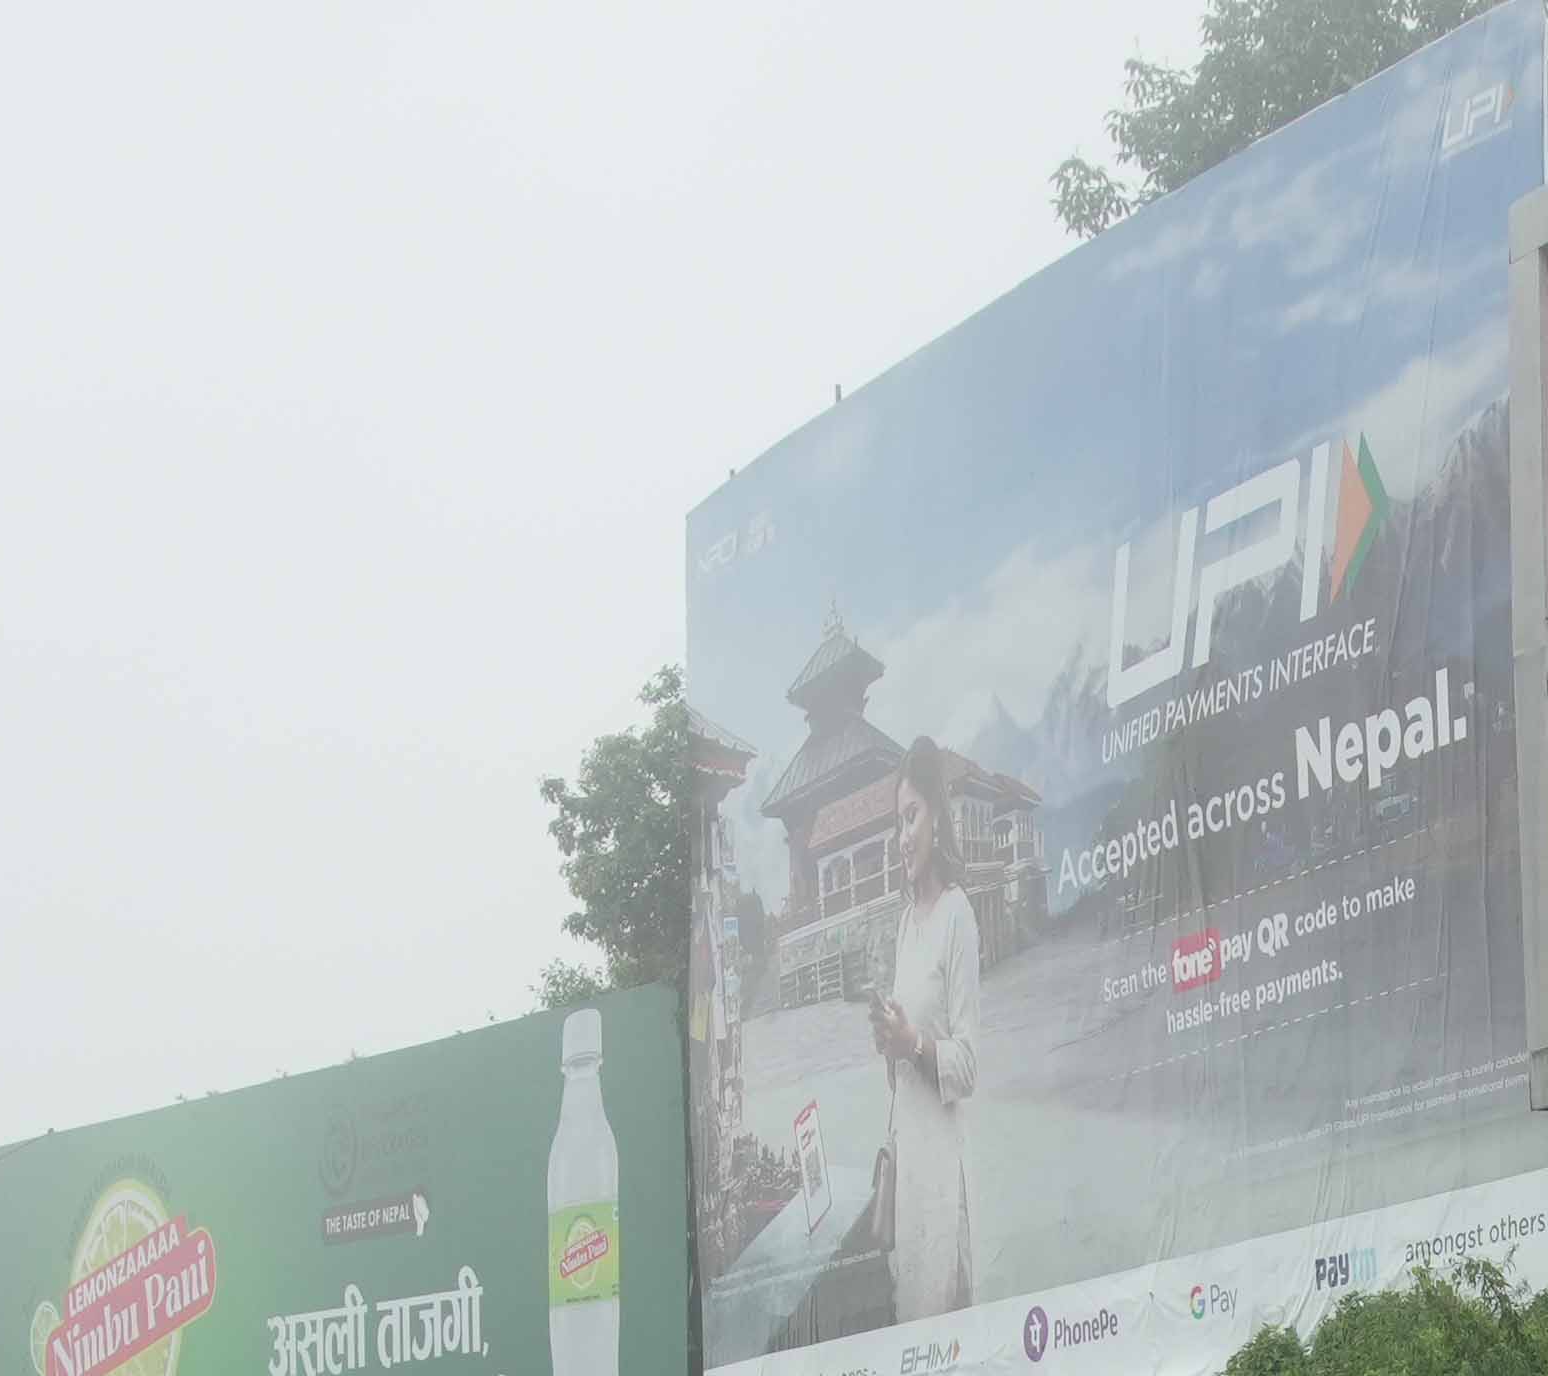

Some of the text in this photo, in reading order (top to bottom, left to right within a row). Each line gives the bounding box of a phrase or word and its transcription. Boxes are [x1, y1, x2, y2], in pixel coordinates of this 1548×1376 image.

[1106, 440, 1331, 710] UPI
[1102, 617, 1376, 763] UNIFIED PAYMENTS INTERFACE
[1058, 668, 1467, 895] Accepted across Nepal.
[1103, 974, 1139, 1002] Scan
[1141, 961, 1167, 990] the
[1257, 912, 1290, 957] QR
[1294, 900, 1338, 937] code
[1341, 895, 1361, 921] to
[1366, 876, 1416, 913] make
[1166, 959, 1343, 1034] hassle-free payments.
[326, 1205, 410, 1234] THE TASTE OF NEPAL
[1404, 1212, 1546, 1264] amongst others
[144, 1239, 210, 1330] Pani
[1210, 1283, 1238, 1320] Pay
[1054, 1309, 1118, 1349] PhonePe
